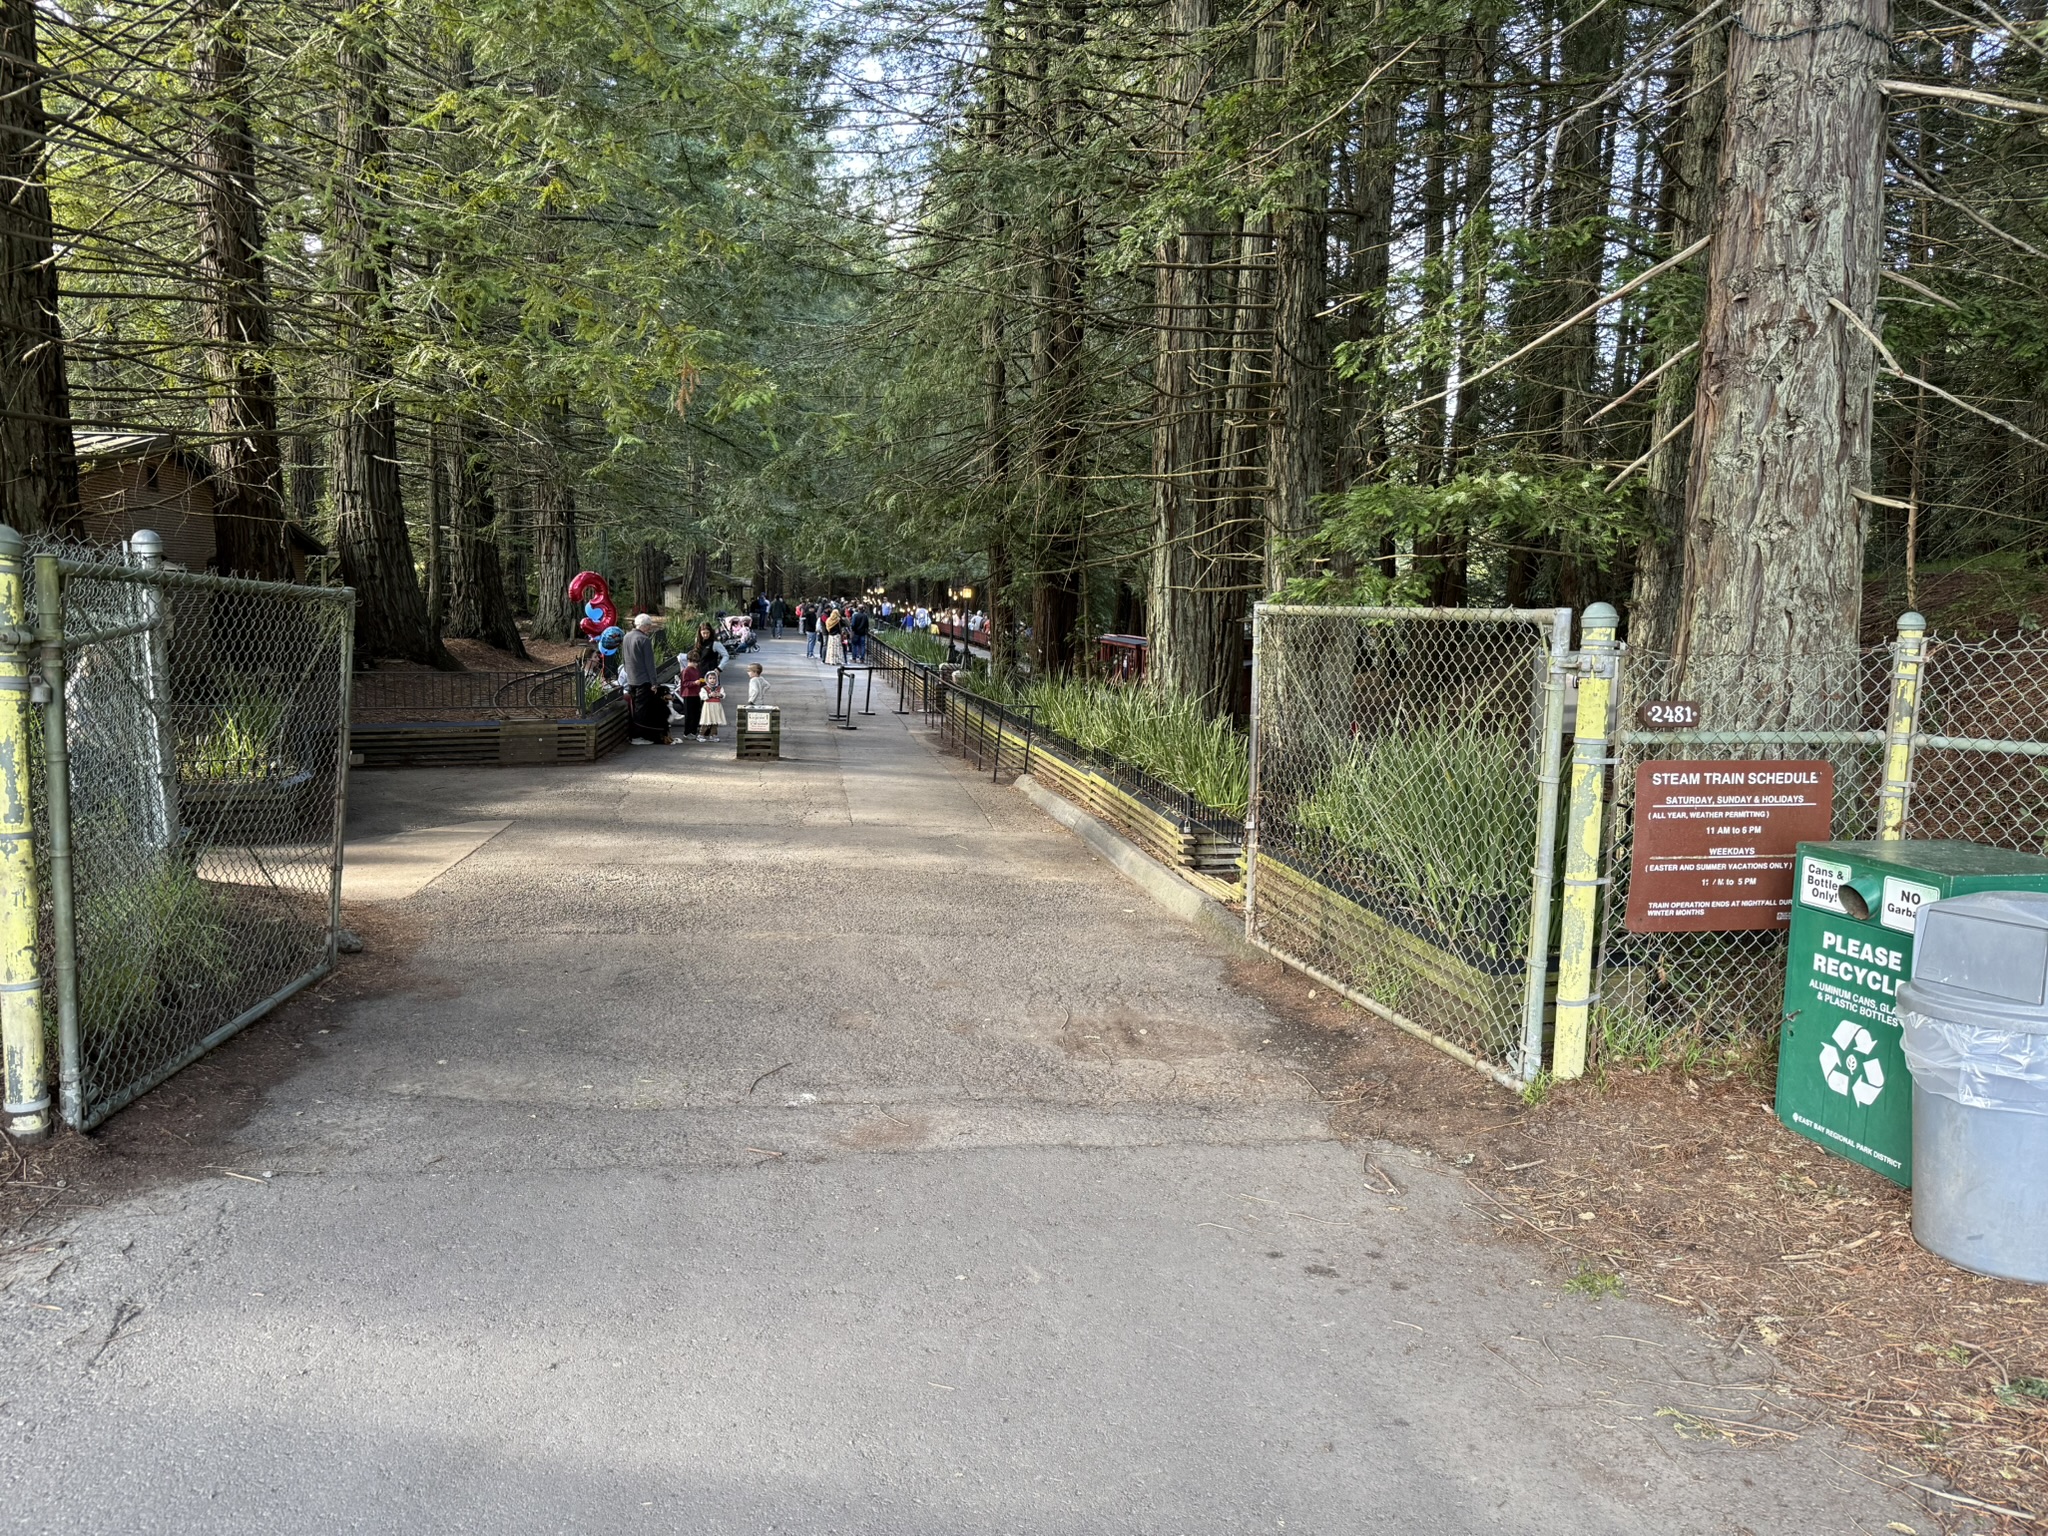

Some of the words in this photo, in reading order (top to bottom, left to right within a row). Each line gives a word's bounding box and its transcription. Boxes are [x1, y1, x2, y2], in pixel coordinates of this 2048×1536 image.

[1651, 705, 1693, 723] 2481
[1652, 772, 1700, 785] STEAM
[1703, 772, 1745, 785] TRAIN
[1747, 771, 1819, 785] SCHEDULE
[1665, 795, 1715, 805] SATURDAY,
[1716, 795, 1752, 804] SUNDAY
[1753, 795, 1760, 804] &
[1761, 795, 1805, 803] HOLIDAYS
[1667, 811, 1688, 819] YEAR,
[1689, 811, 1724, 819] WEATHER
[1706, 826, 1715, 834] 11
[1716, 826, 1731, 834] AM
[1732, 826, 1741, 834] to
[1748, 825, 1762, 834] PM
[1709, 847, 1756, 856] WEEKDAYS
[1695, 863, 1727, 871] SUMMER
[1728, 862, 1768, 870] VACATIONS
[1808, 863, 1834, 878] Cans
[1836, 870, 1844, 881] &
[1725, 878, 1735, 886] to
[1737, 877, 1743, 885] 5
[1744, 877, 1757, 885] PM
[1807, 874, 1838, 891] Bottle
[1811, 887, 1838, 903] Only!
[1900, 890, 1921, 906] NO
[1711, 900, 1730, 908] ENDS
[1730, 900, 1740, 908] AT
[1887, 902, 1917, 919] Garba
[1647, 909, 1674, 917] WINTER
[1822, 930, 1903, 972] PLEASE
[1808, 978, 1852, 1001] ALUMINUM
[1852, 993, 1878, 1011] CANS,
[1816, 991, 1824, 1001] &
[1824, 993, 1858, 1013] PLASTIC
[1859, 1006, 1899, 1028] BOTTLES
[1798, 1115, 1814, 1128] EAST
[1813, 1122, 1825, 1134] BAY
[1825, 1128, 1855, 1148] REGIONAL
[1855, 1142, 1873, 1157] PARK
[1873, 1150, 1902, 1170] DISTRICT
